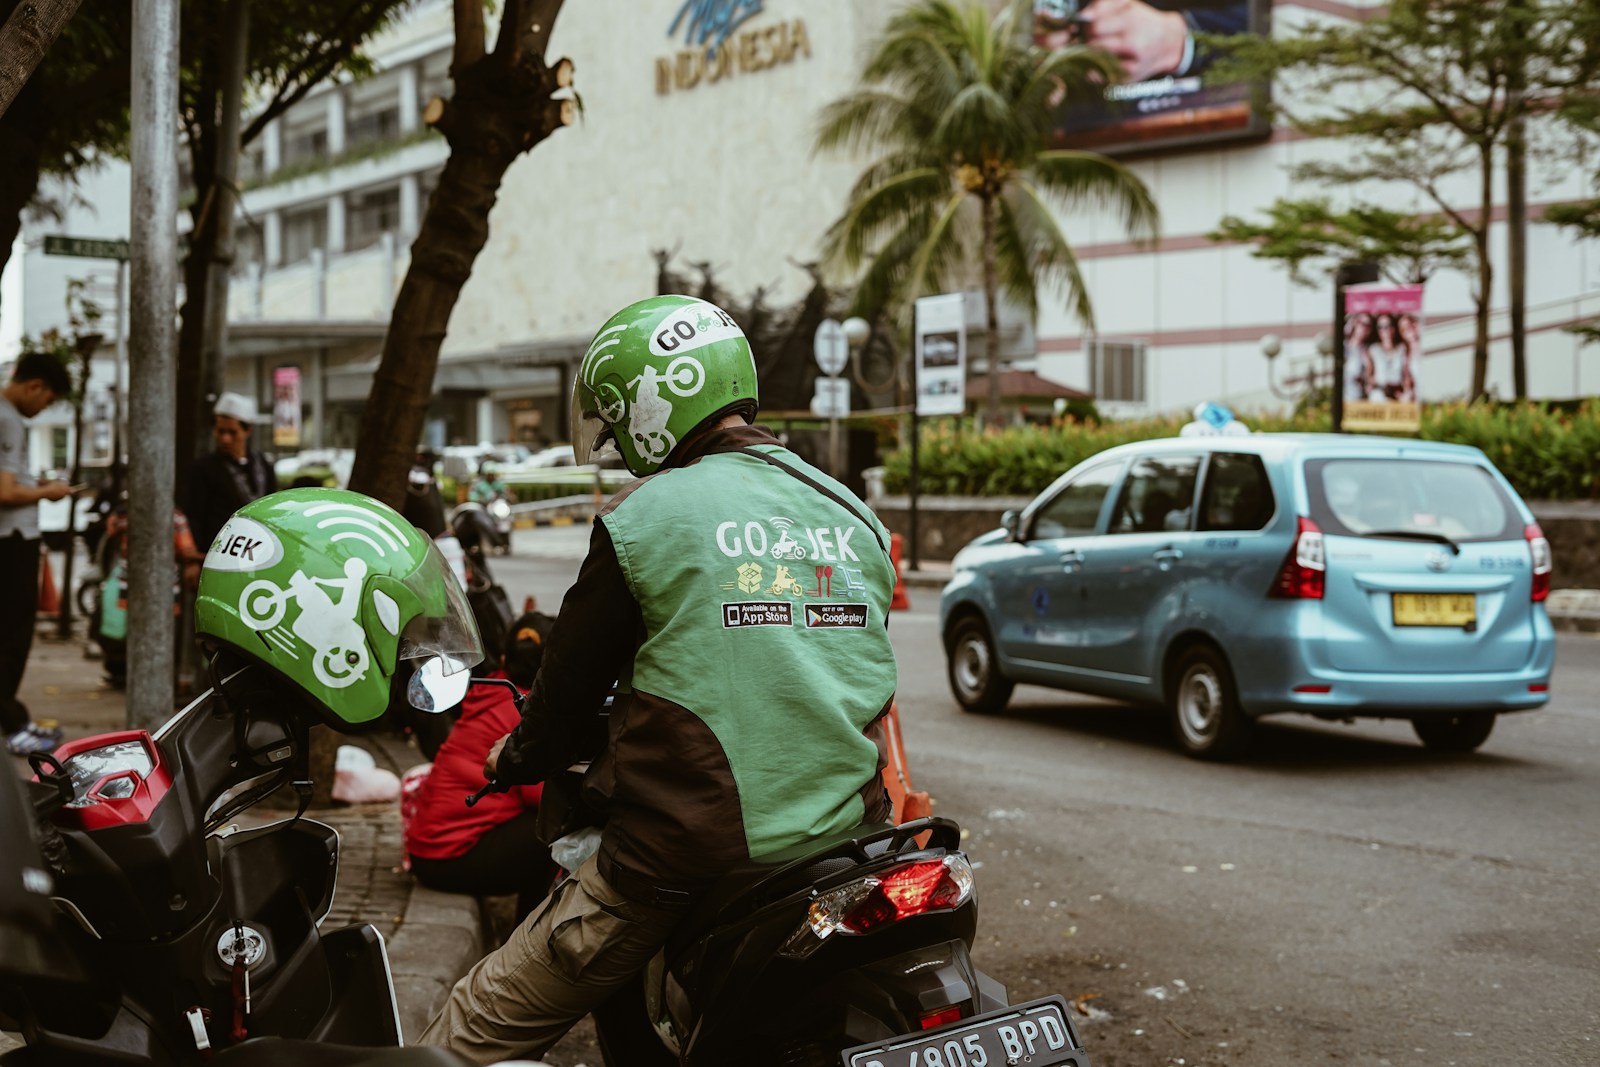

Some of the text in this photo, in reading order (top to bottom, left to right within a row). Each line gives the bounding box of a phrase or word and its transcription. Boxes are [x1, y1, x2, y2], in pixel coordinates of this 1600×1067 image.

[655, 19, 812, 96] INDONESIA
[656, 320, 696, 351] GO
[221, 534, 263, 561] JEK
[715, 521, 861, 562] GO JEK
[743, 611, 789, 624] App Store
[904, 960, 944, 974] HONDA
[997, 1015, 1065, 1059] BPD
